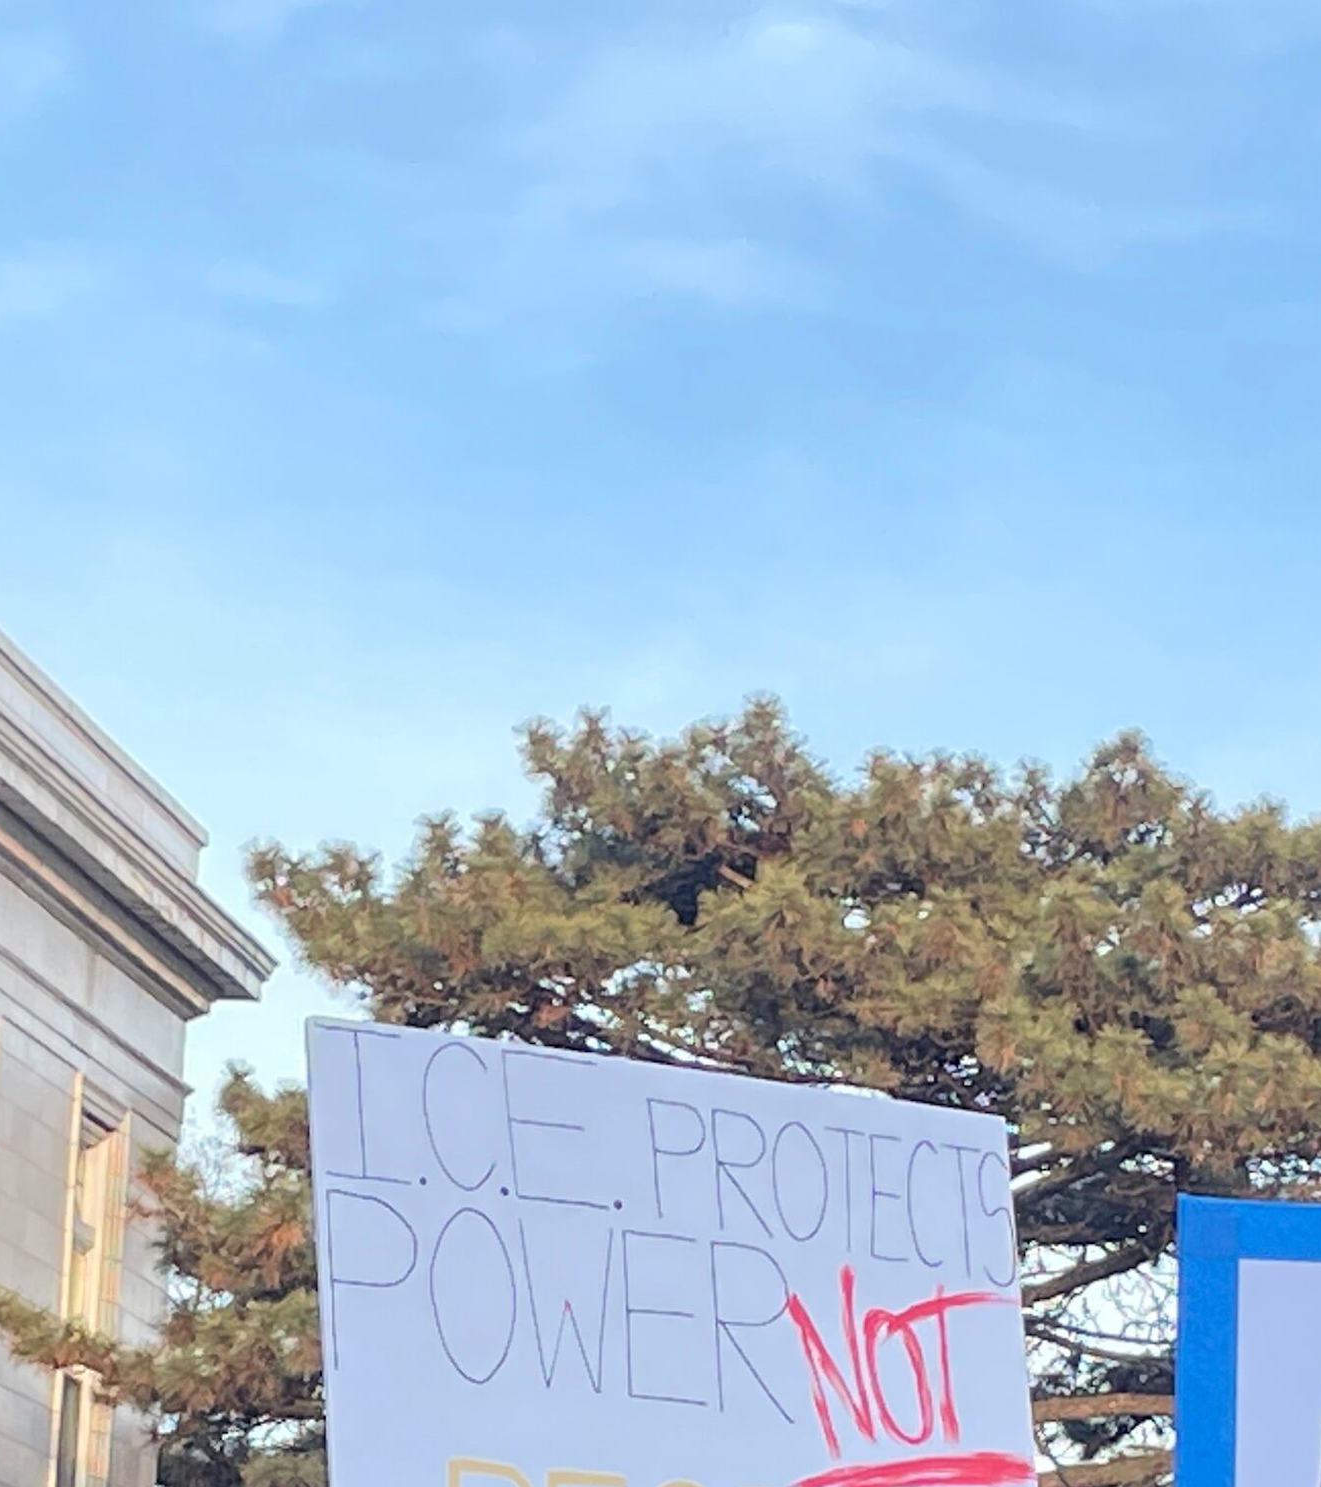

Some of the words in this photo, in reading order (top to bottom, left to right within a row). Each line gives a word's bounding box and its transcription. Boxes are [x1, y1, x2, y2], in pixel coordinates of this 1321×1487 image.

[314, 1022, 623, 1211] I.C.E.
[646, 1097, 1018, 1288] PROTECTS
[326, 1188, 795, 1424] POWER
[786, 1264, 1022, 1460] NOT
